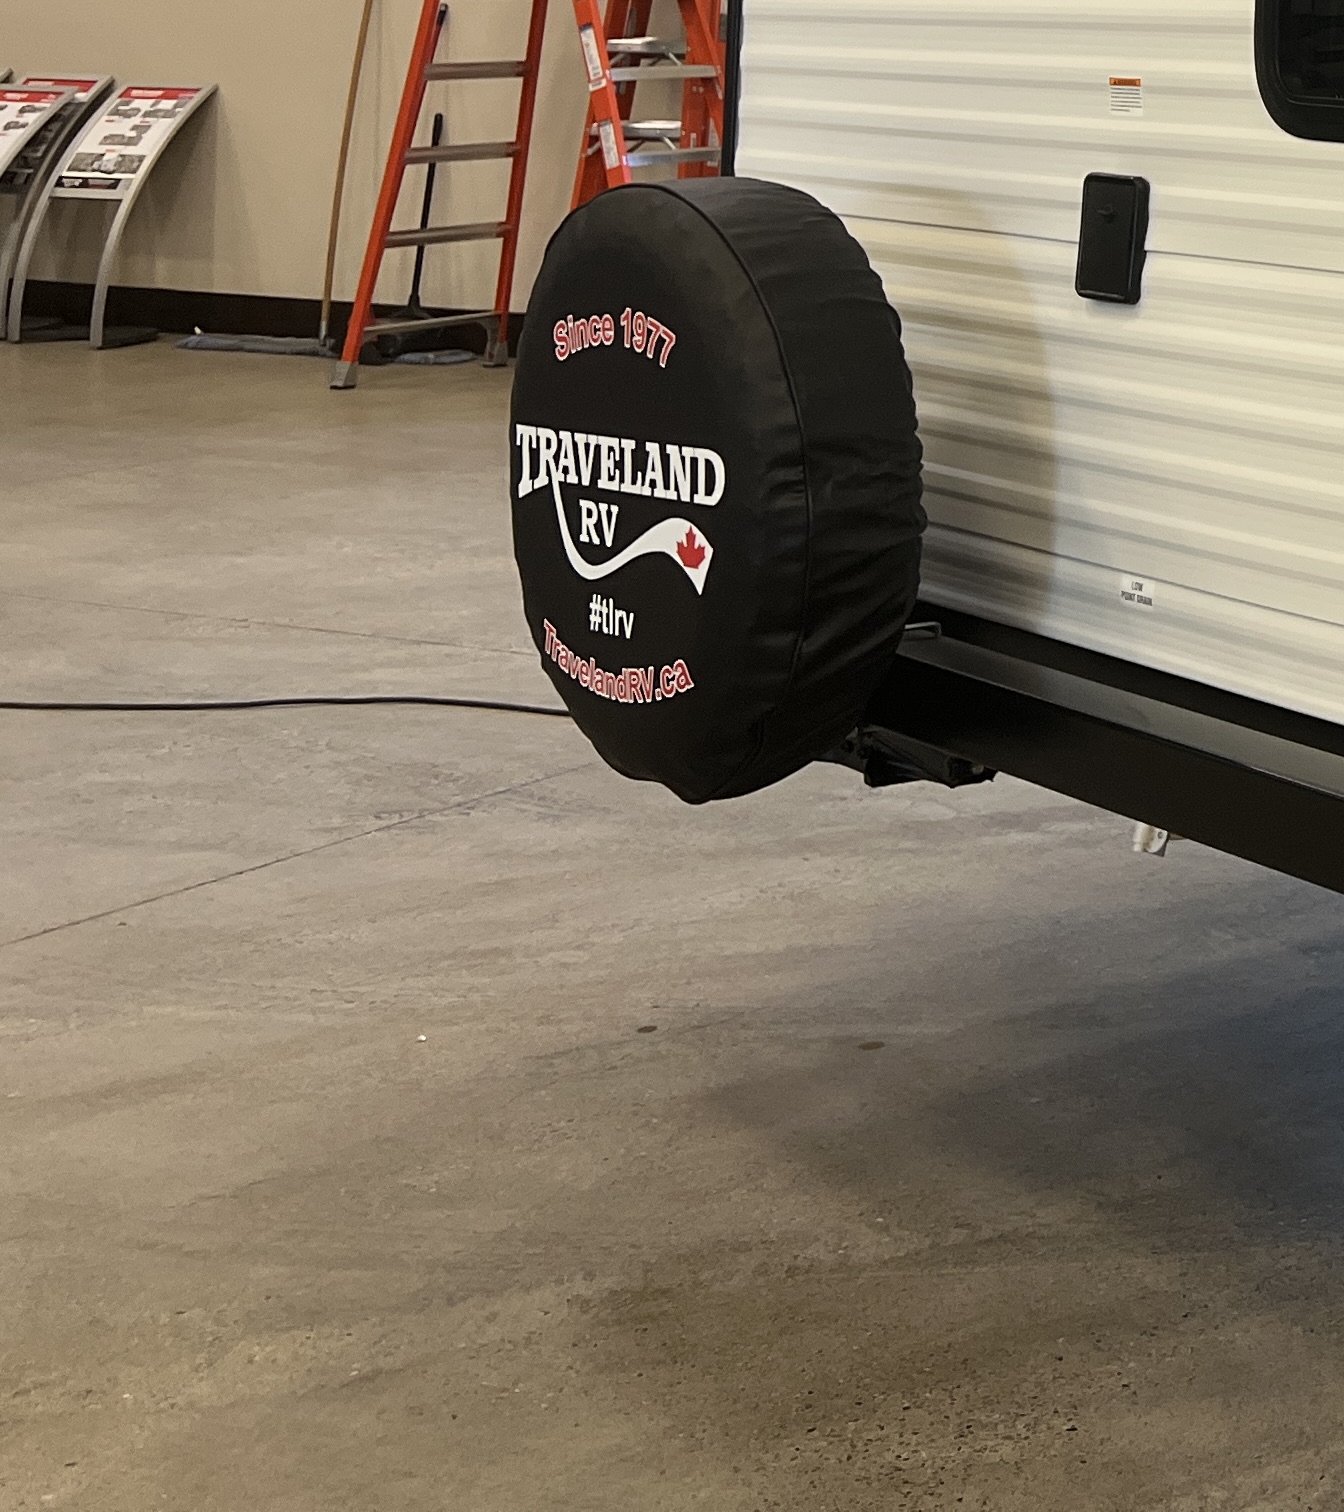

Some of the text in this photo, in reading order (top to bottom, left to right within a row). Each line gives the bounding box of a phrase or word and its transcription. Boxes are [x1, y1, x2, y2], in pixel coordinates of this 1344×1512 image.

[552, 307, 677, 369] Since 1977
[515, 423, 726, 507] TRAVELAND
[579, 498, 620, 548] RV
[588, 593, 635, 640] #tlrv
[543, 618, 695, 704] TravelandRV.ca
